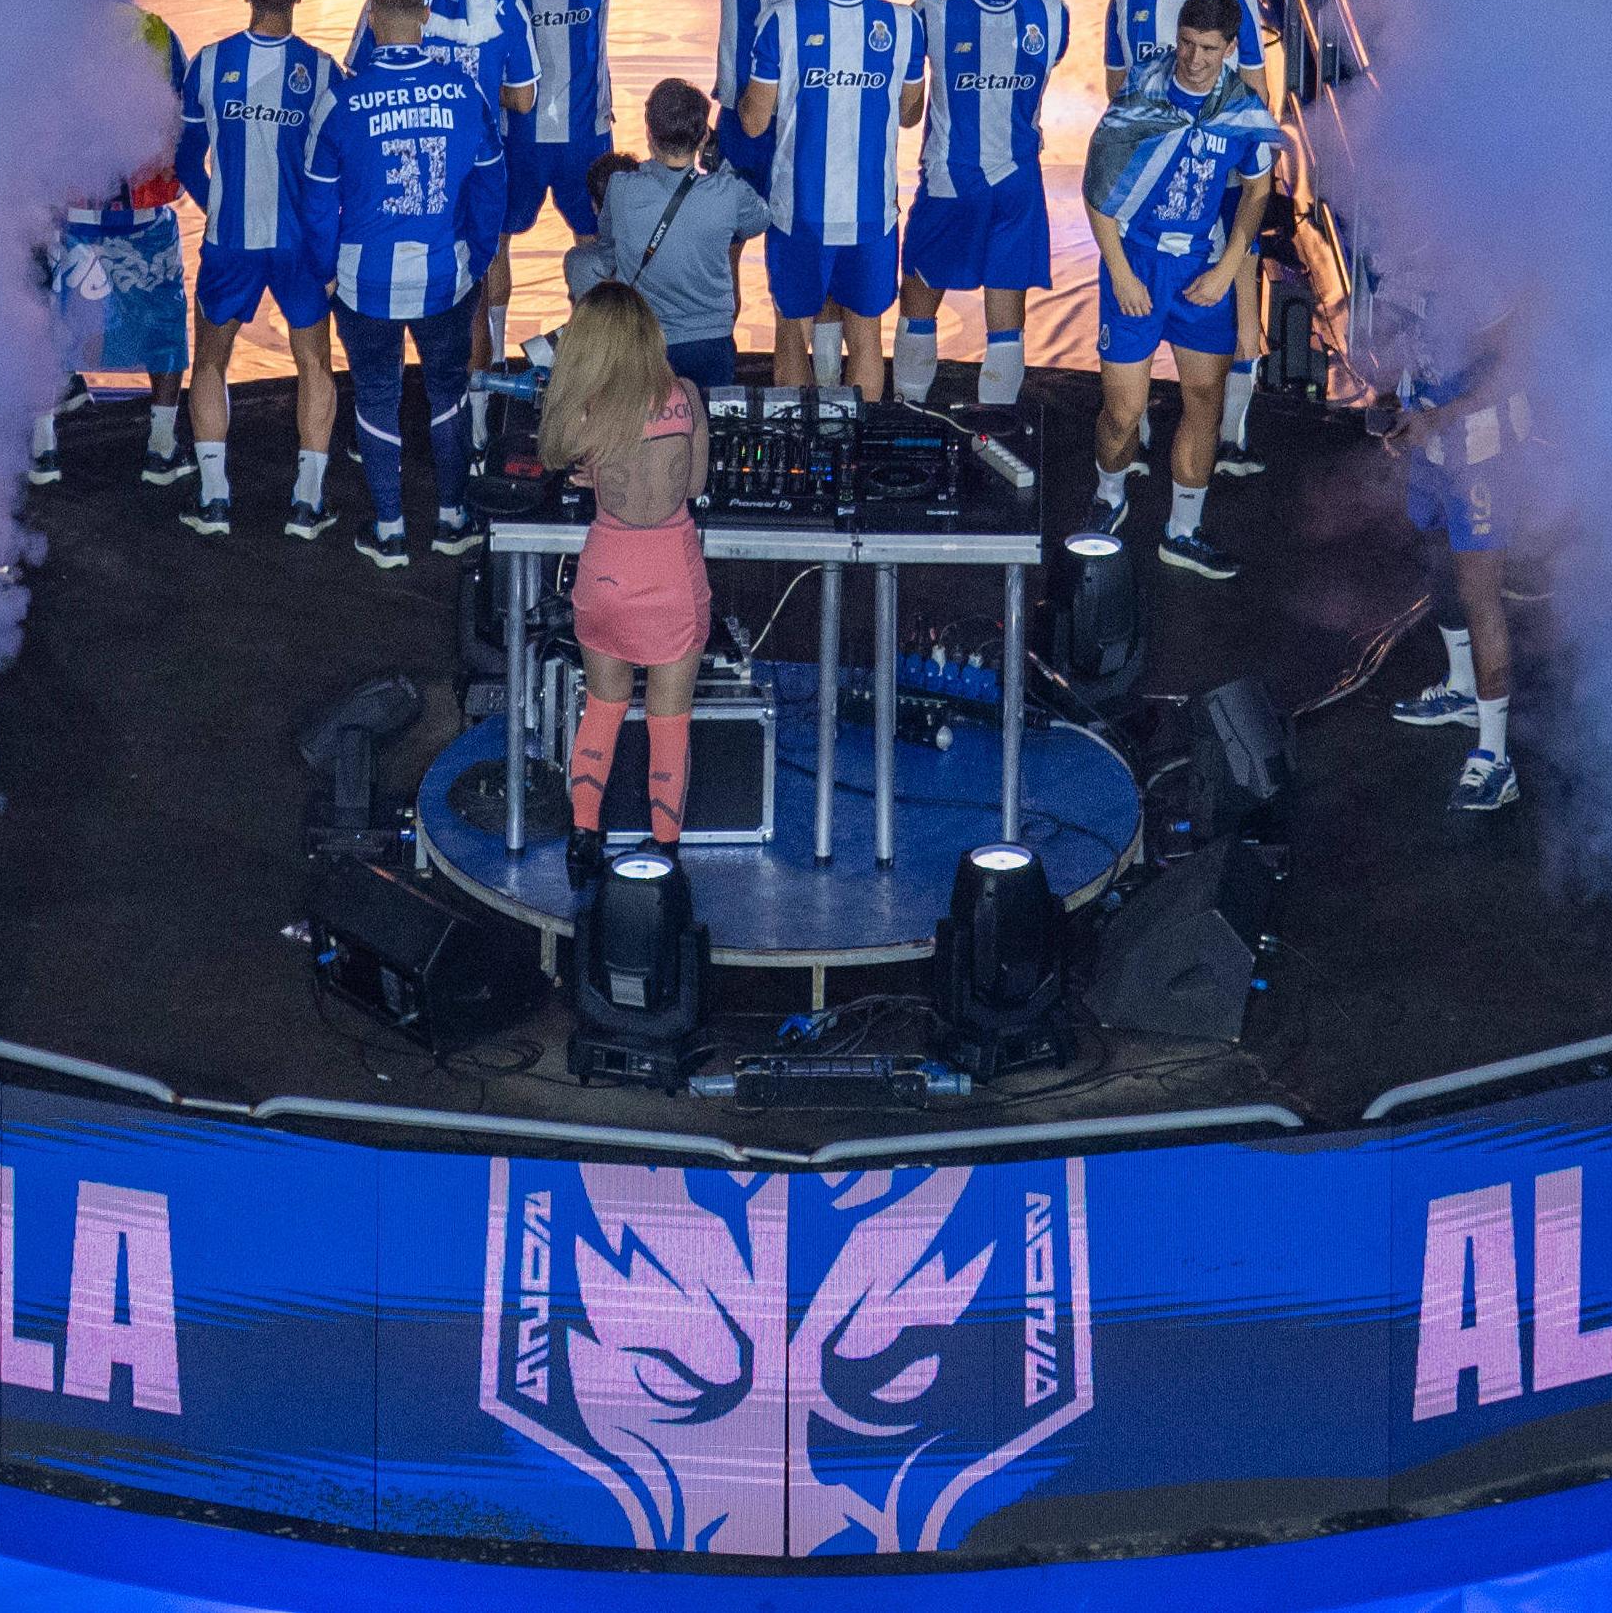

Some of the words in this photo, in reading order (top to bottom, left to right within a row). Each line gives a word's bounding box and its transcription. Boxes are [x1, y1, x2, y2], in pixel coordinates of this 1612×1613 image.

[529, 6, 592, 29] etano
[805, 68, 887, 88] Betano
[954, 74, 1037, 92] Betano
[349, 88, 412, 113] SUPER
[414, 84, 468, 105] BOCK
[222, 100, 306, 127] Betano
[379, 136, 455, 217] 31
